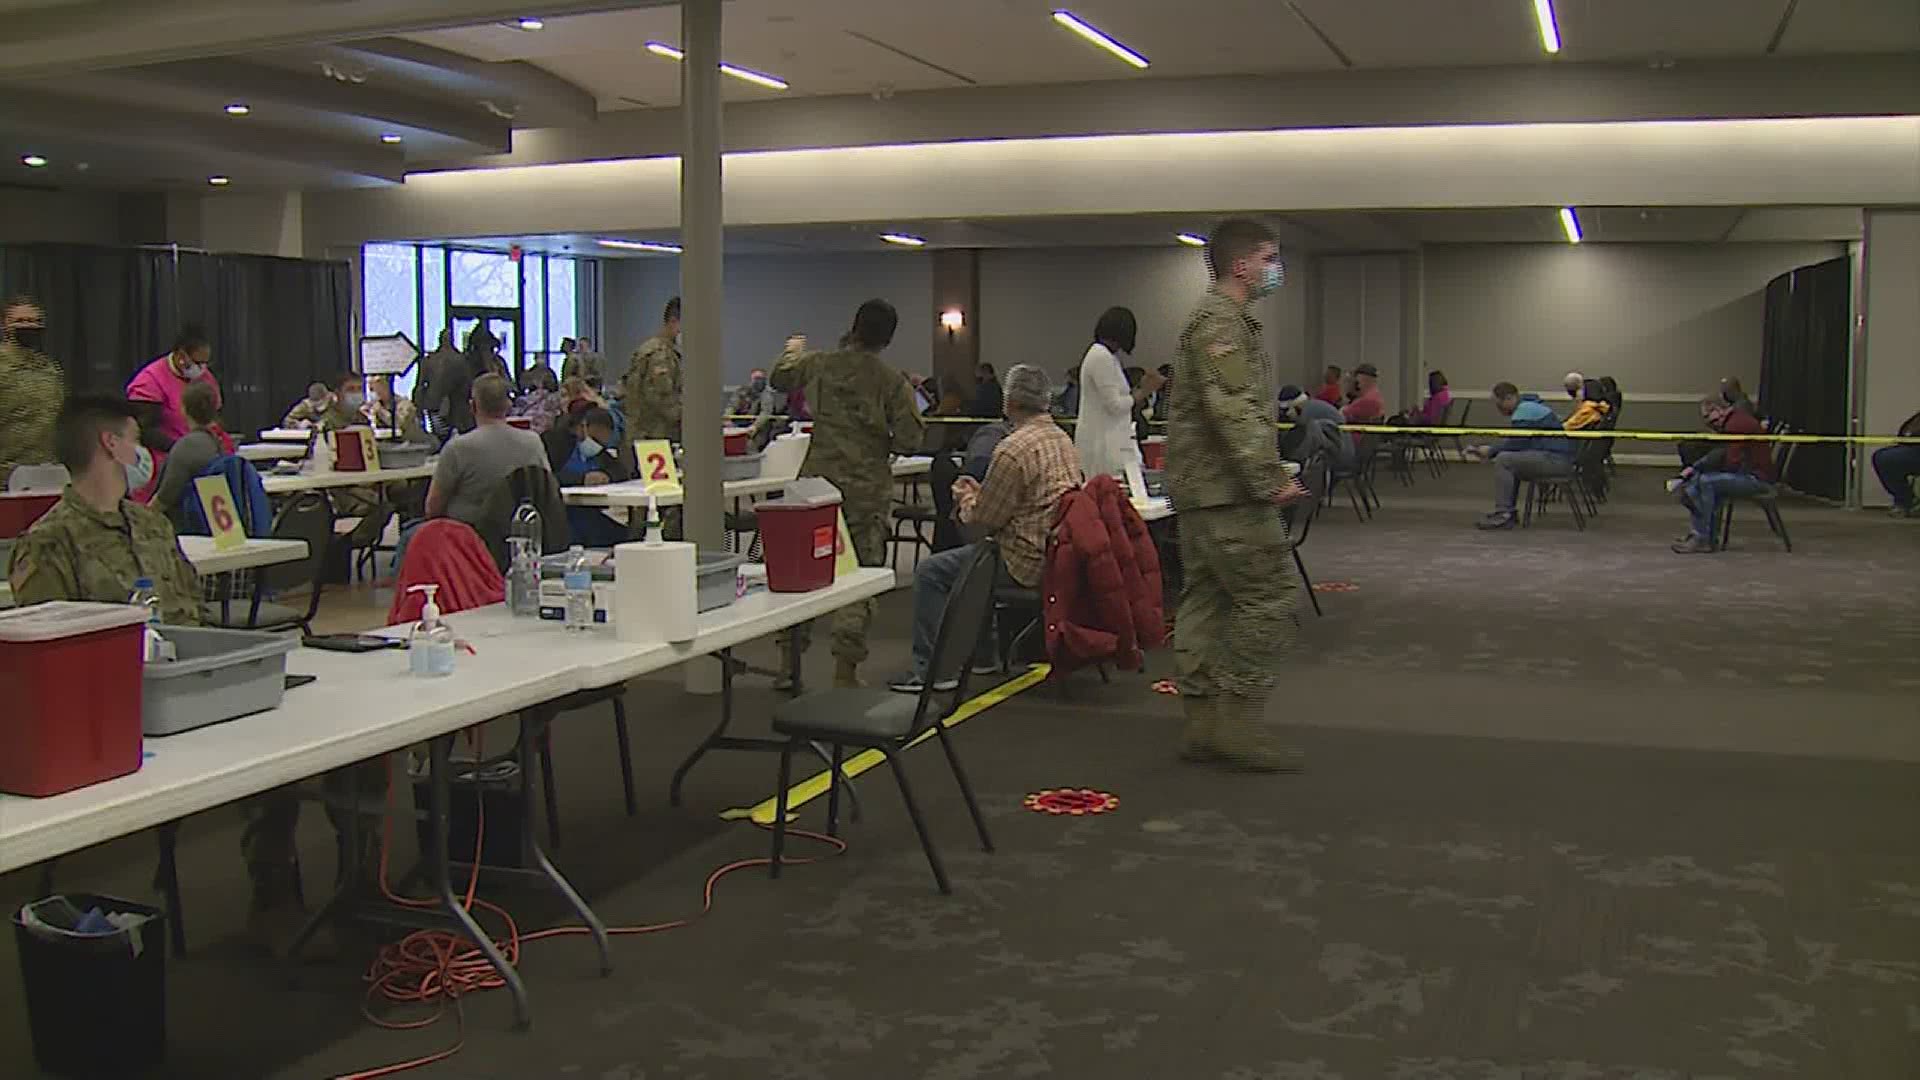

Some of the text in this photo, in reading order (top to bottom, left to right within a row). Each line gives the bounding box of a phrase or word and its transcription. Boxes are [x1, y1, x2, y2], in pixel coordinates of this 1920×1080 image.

[364, 439, 375, 461] 3
[647, 453, 669, 480] 2
[211, 495, 233, 531] 6
